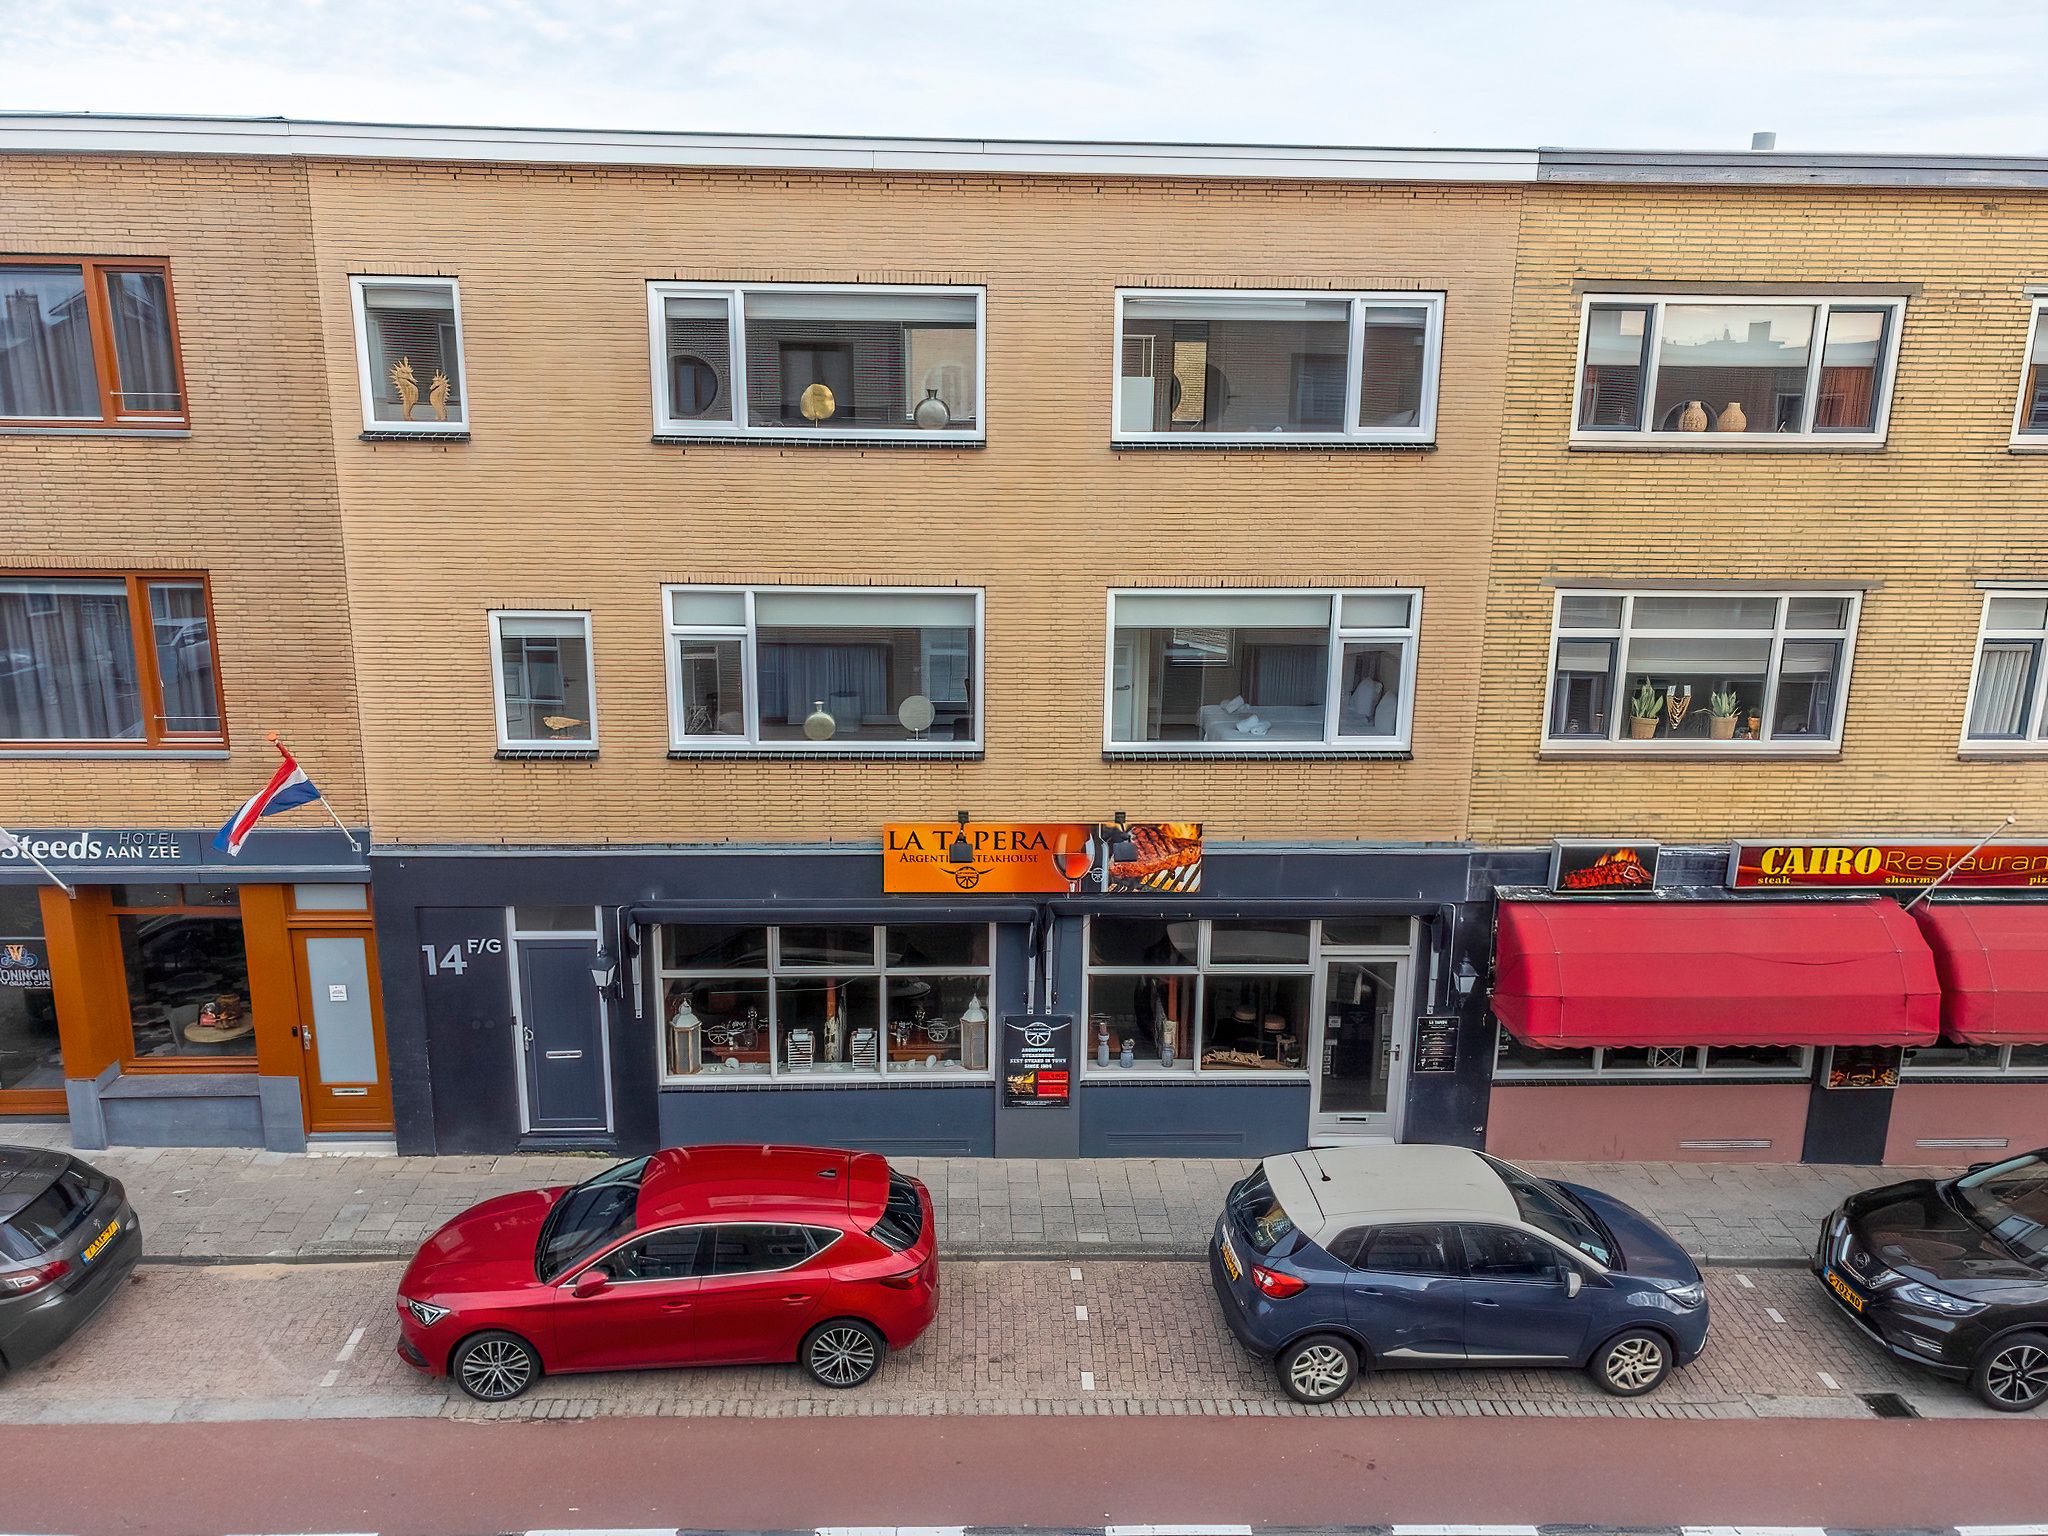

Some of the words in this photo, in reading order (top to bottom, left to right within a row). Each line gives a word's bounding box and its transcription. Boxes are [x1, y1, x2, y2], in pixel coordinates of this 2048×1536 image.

[1, 833, 102, 859] Steeds
[119, 832, 179, 845] HOTEL
[889, 830, 924, 850] LA
[105, 846, 143, 858] AAN
[148, 846, 181, 858] ZEE
[1761, 847, 1882, 875] CAIRO
[1885, 850, 2048, 871] Restauran
[1758, 875, 1791, 885] steak
[421, 944, 468, 976] 14
[467, 938, 502, 954] F/G
[0, 968, 51, 984] ONINGIN
